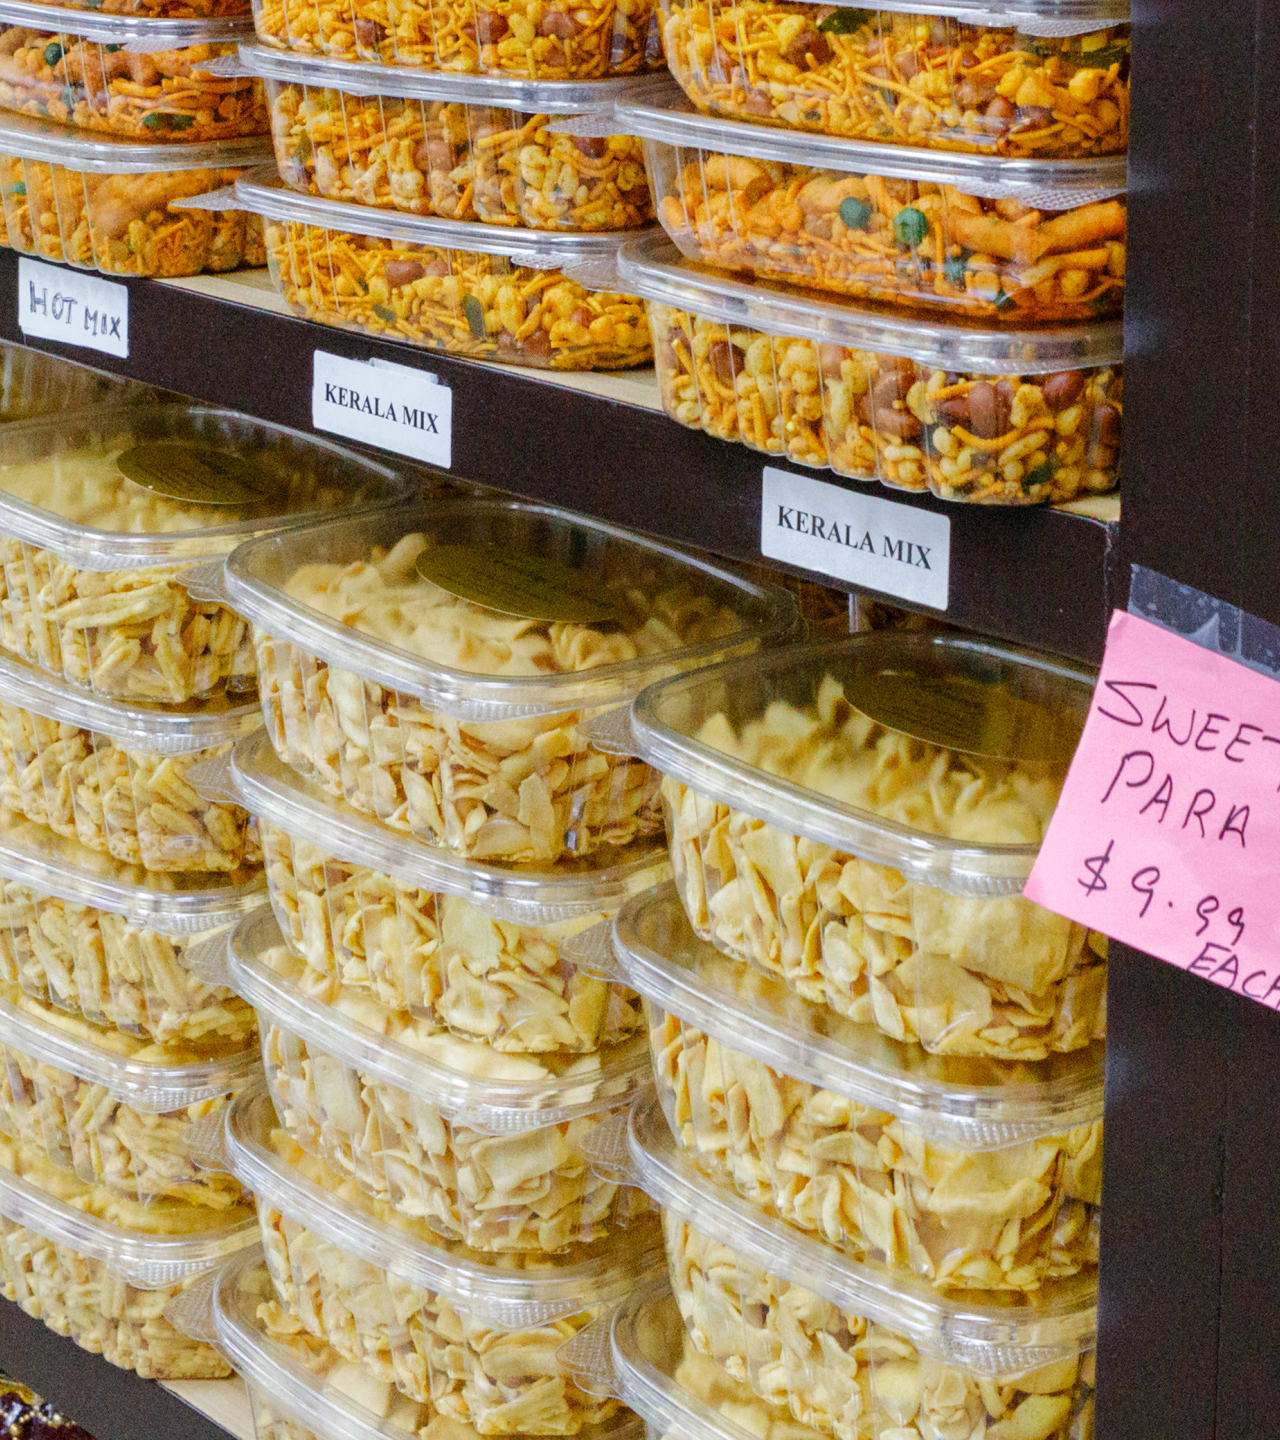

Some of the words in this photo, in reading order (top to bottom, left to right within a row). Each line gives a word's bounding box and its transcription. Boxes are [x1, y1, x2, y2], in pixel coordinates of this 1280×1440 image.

[29, 280, 78, 324] HOT
[84, 305, 121, 342] MIX
[324, 382, 397, 423] KERALA
[402, 405, 439, 435] MIX
[777, 505, 876, 554] KERALA
[883, 534, 932, 570] MIX
[1100, 750, 1251, 849] PARA
